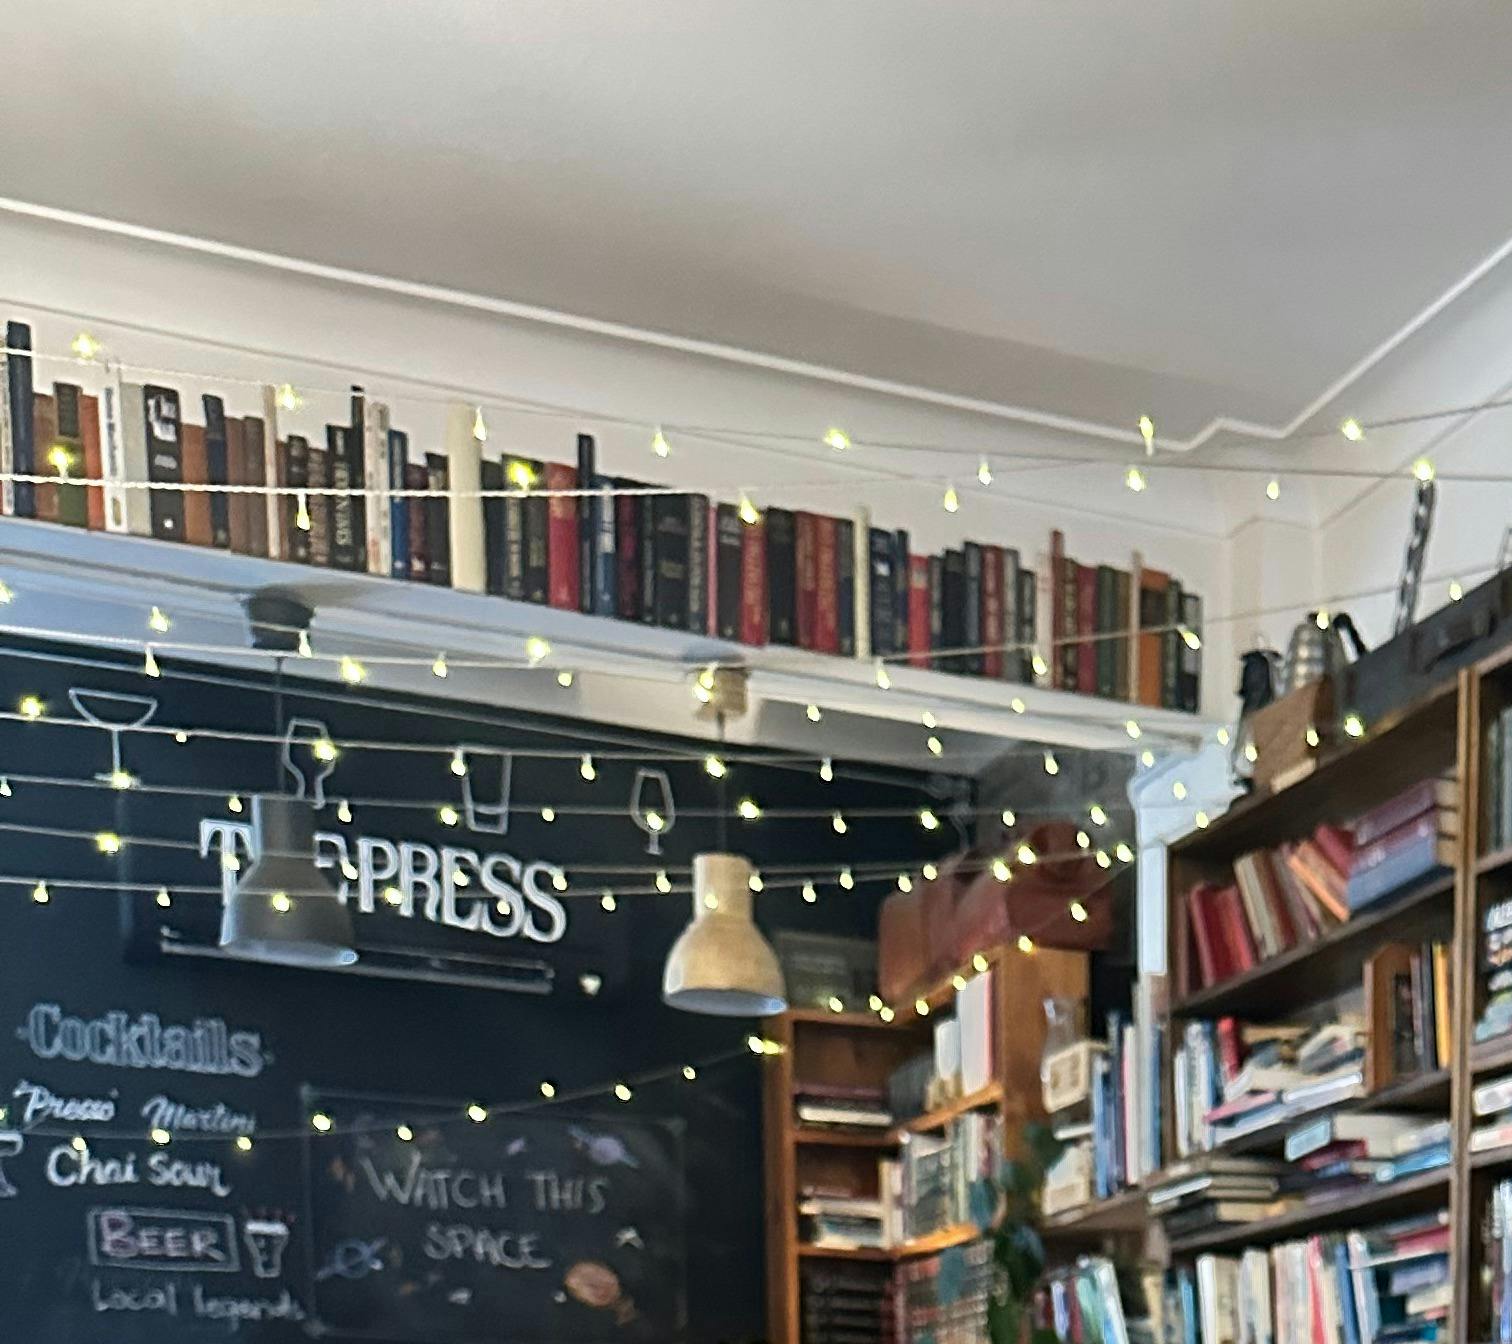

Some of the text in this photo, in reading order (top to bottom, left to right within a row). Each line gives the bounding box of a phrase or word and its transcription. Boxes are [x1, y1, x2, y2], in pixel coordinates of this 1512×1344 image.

[357, 836, 568, 944] PRESS
[28, 1003, 265, 1078] Cocktails
[47, 1145, 138, 1187] Chai
[358, 1149, 612, 1213] WATCH THIS
[101, 1209, 226, 1262] BEER
[423, 1224, 554, 1271] SPACE
